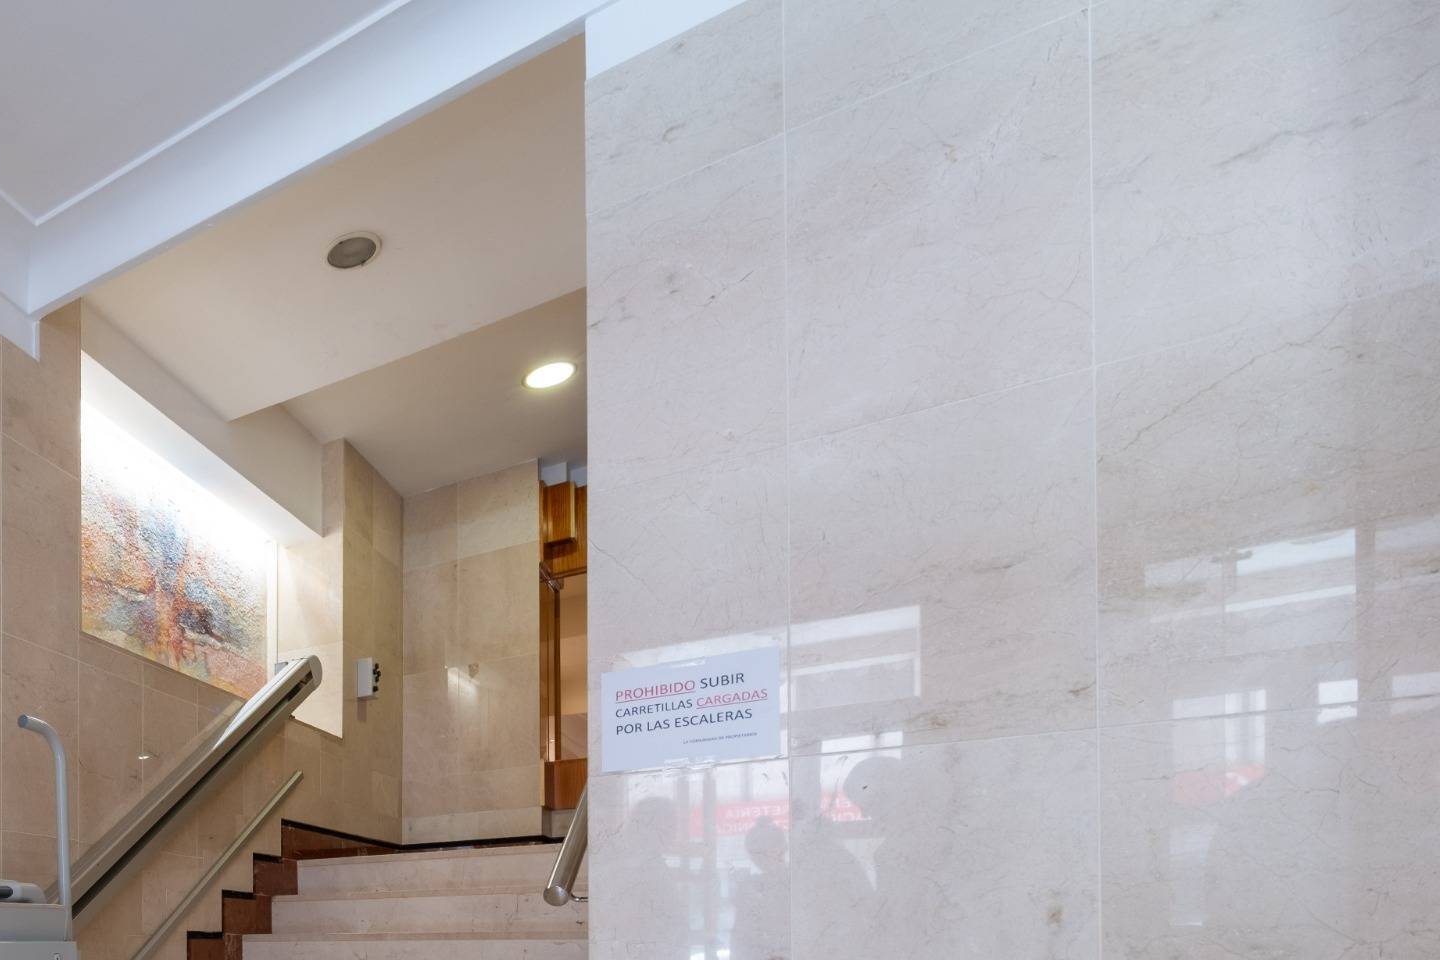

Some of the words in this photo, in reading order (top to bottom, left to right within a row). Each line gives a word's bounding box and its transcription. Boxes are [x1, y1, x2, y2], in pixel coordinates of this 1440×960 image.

[615, 680, 696, 702] PROHIBIDO
[699, 672, 745, 689] SUBIR
[615, 698, 693, 718] CARRETILLAS
[696, 688, 768, 708] CARGADAS
[616, 723, 642, 735] POR
[647, 719, 670, 732] LAS
[674, 708, 753, 728] ESCALERAS
